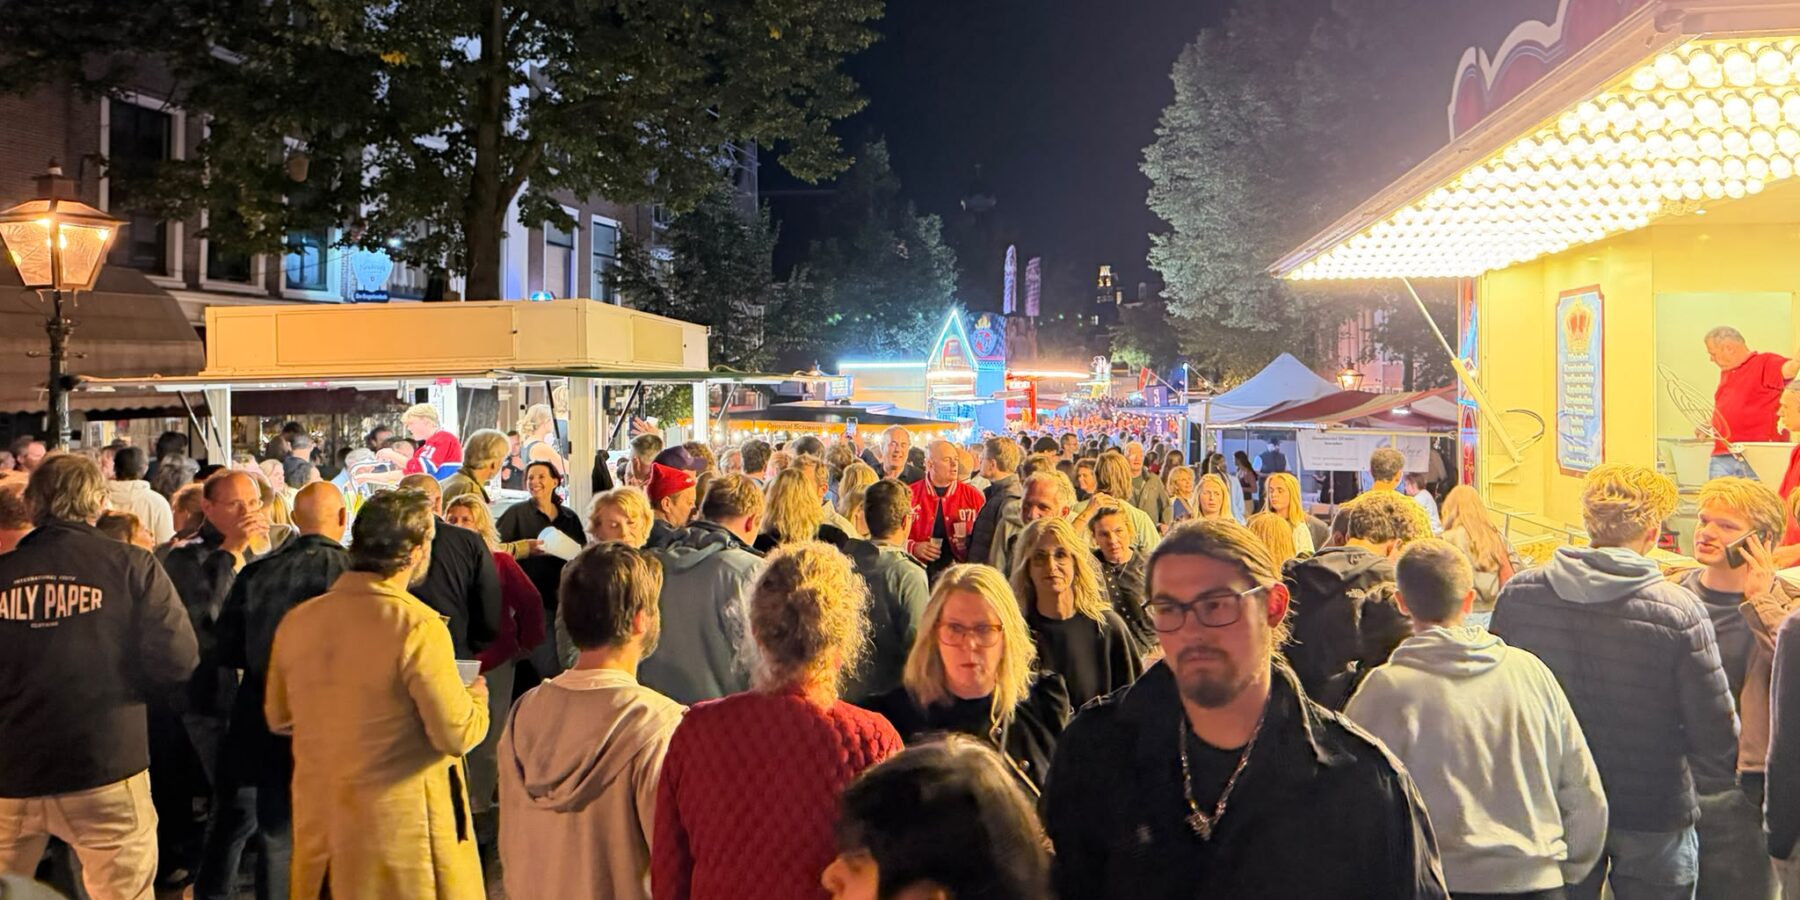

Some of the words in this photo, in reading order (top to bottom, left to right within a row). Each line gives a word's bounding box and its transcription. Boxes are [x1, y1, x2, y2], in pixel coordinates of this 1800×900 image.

[959, 508, 976, 521] 071
[0, 584, 39, 620] AILY
[44, 583, 103, 620] PAPER
